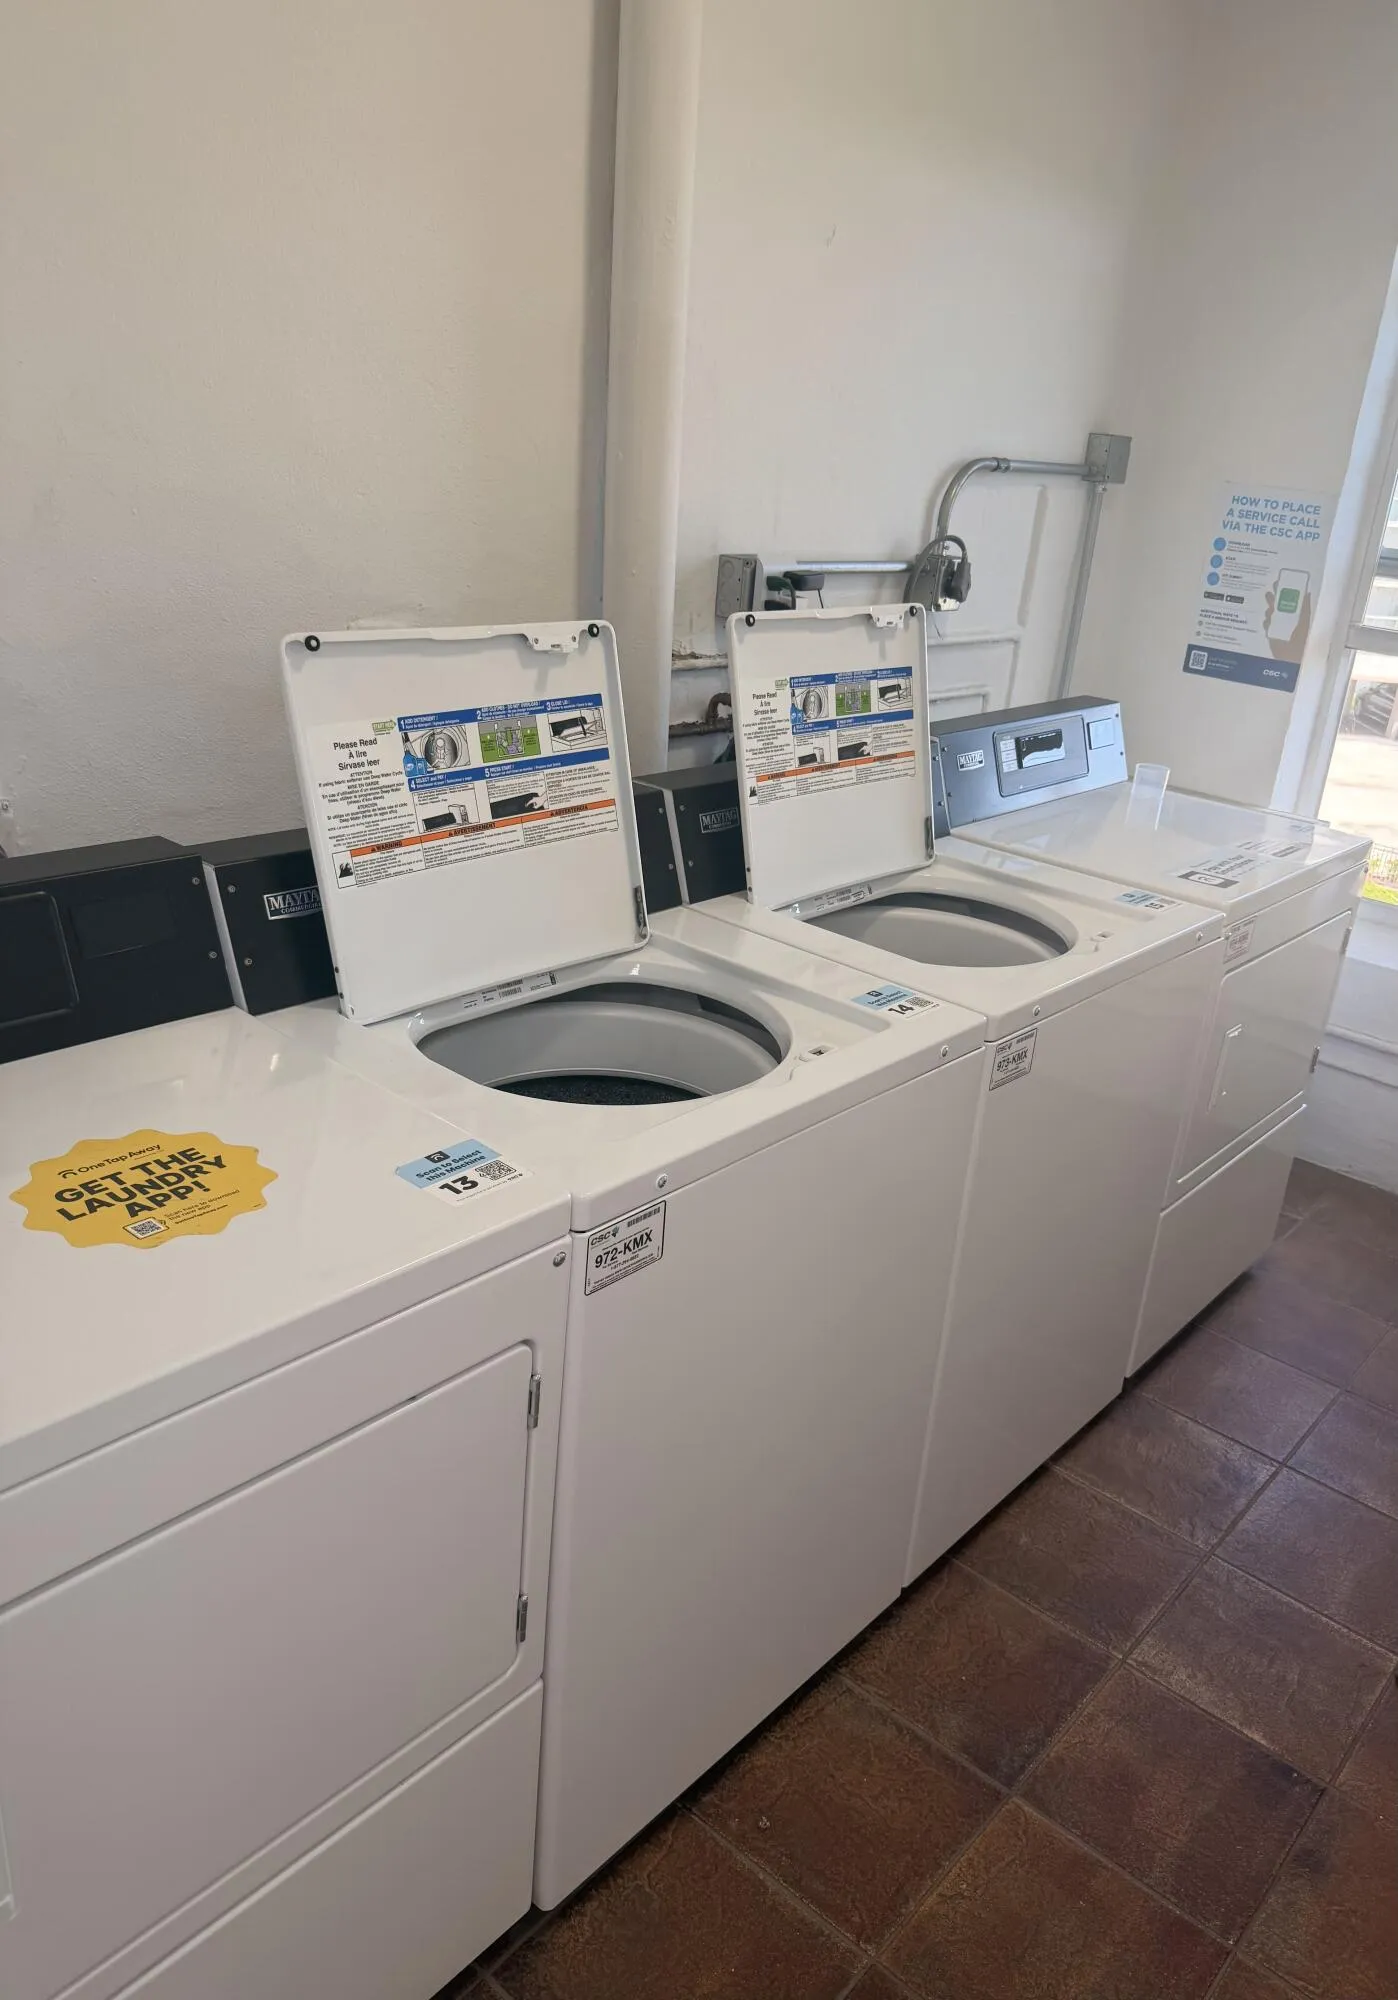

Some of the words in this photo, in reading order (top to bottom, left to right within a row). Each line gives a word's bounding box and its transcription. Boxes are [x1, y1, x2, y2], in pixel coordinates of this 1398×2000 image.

[1232, 496, 1260, 508] HOW
[1264, 499, 1279, 510] TO
[1282, 503, 1321, 515] PLACE
[1227, 508, 1234, 518] A
[1238, 510, 1287, 525] SERVICE
[1290, 517, 1320, 528] CALL
[1222, 520, 1241, 532] VIA
[1245, 524, 1266, 535] THE
[1269, 526, 1293, 538] CSC
[1295, 530, 1320, 542] APP
[1263, 669, 1280, 677] CSC
[546, 702, 551, 710] 3
[476, 710, 482, 720] 2
[400, 720, 405, 730] 1
[333, 741, 357, 750] Please
[359, 738, 377, 746] Read
[349, 750, 354, 759] À
[356, 750, 367, 758] lire
[367, 759, 380, 767] leer
[485, 768, 490, 778] 5
[411, 780, 415, 789] 4
[376, 840, 402, 851] WARNING
[268, 890, 319, 910] MAYTA
[888, 1004, 915, 1015] 14
[416, 1165, 441, 1178] Scan
[441, 1160, 452, 1169] to
[452, 1149, 482, 1164] Select
[447, 1155, 486, 1174] Machine
[54, 1171, 129, 1204] GET
[130, 1147, 206, 1176] THE
[56, 1155, 227, 1221] LAUNDRY
[439, 1176, 479, 1195] 13
[125, 1180, 211, 1218] APP!
[590, 1231, 611, 1246] CSC
[595, 1230, 653, 1268] 972-KMX
